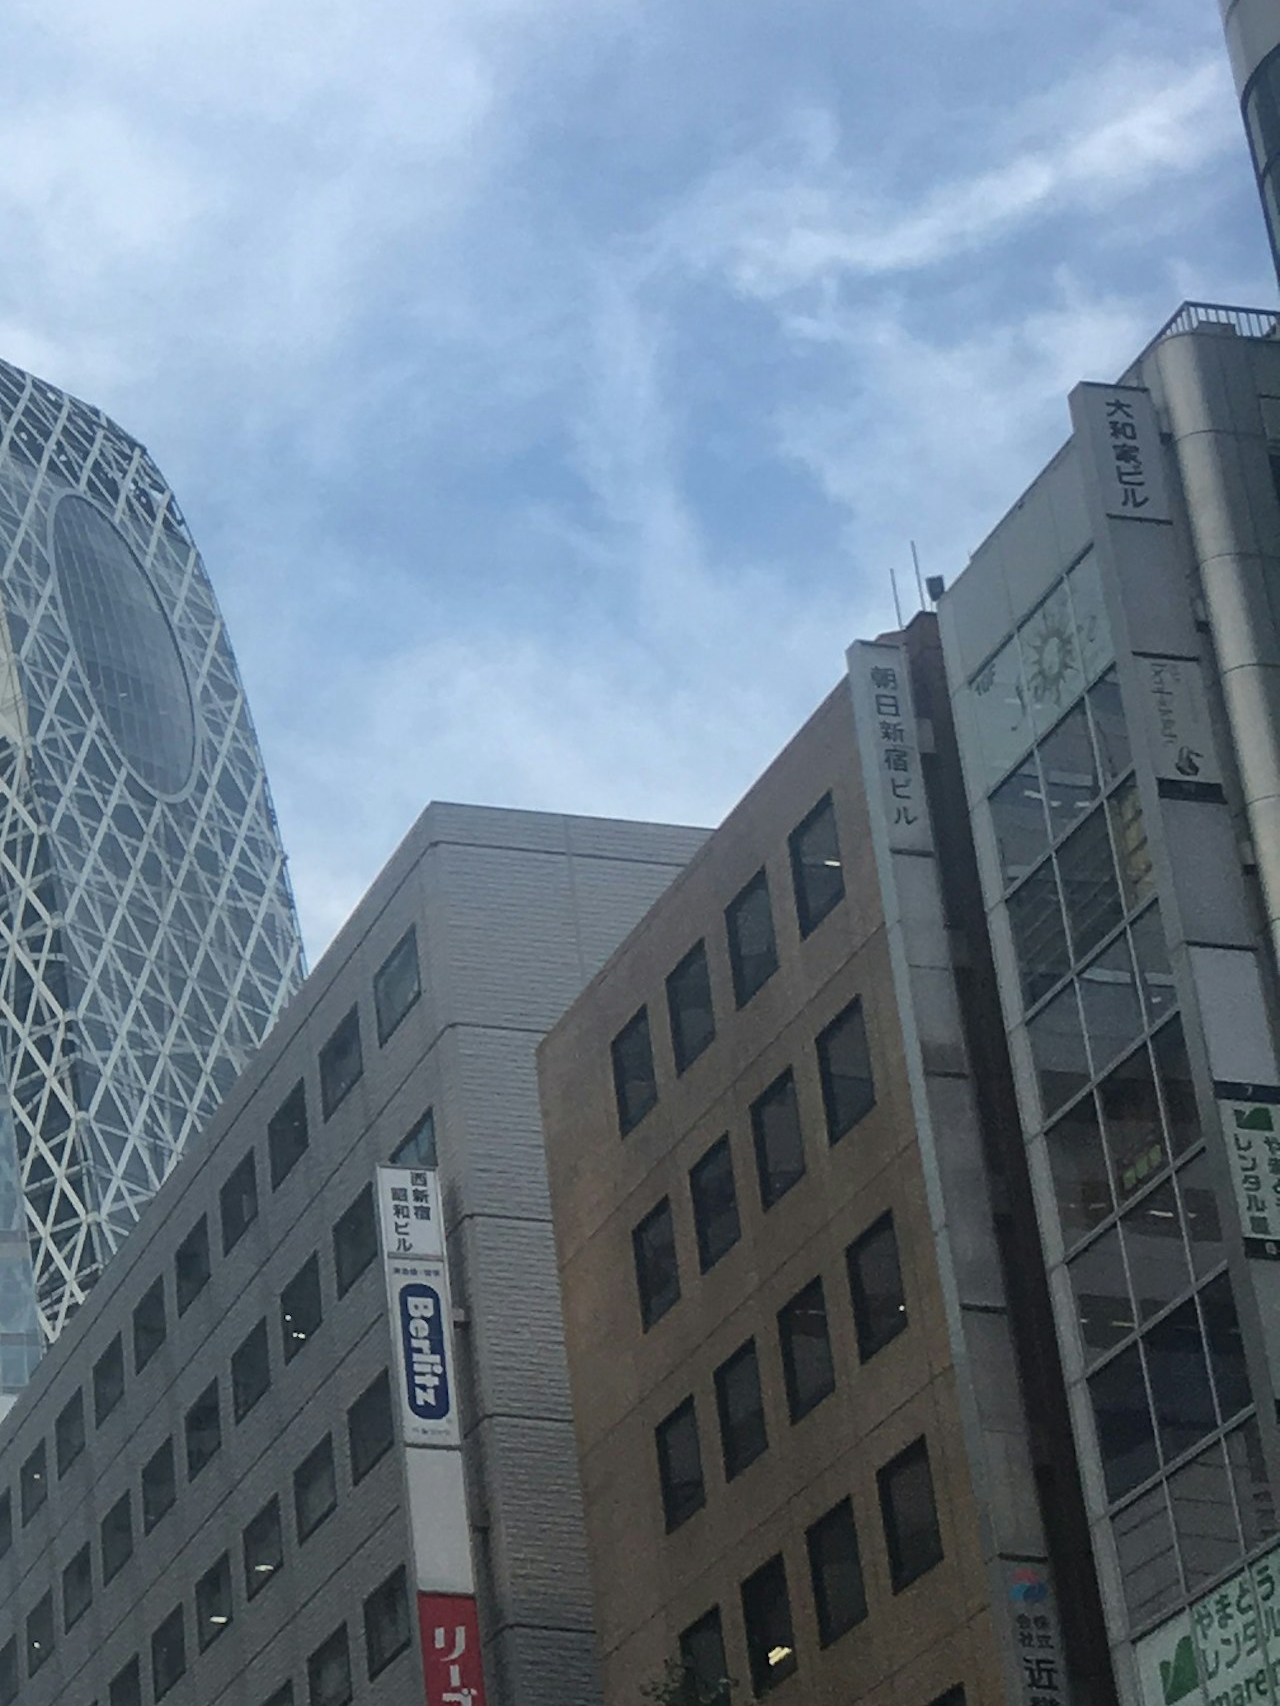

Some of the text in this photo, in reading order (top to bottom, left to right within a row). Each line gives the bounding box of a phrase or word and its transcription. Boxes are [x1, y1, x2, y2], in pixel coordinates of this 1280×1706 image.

[872, 666, 915, 826] 朝日新宿ビル
[410, 1171, 431, 1221] 西新宿
[406, 1296, 444, 1406] Berlitz
